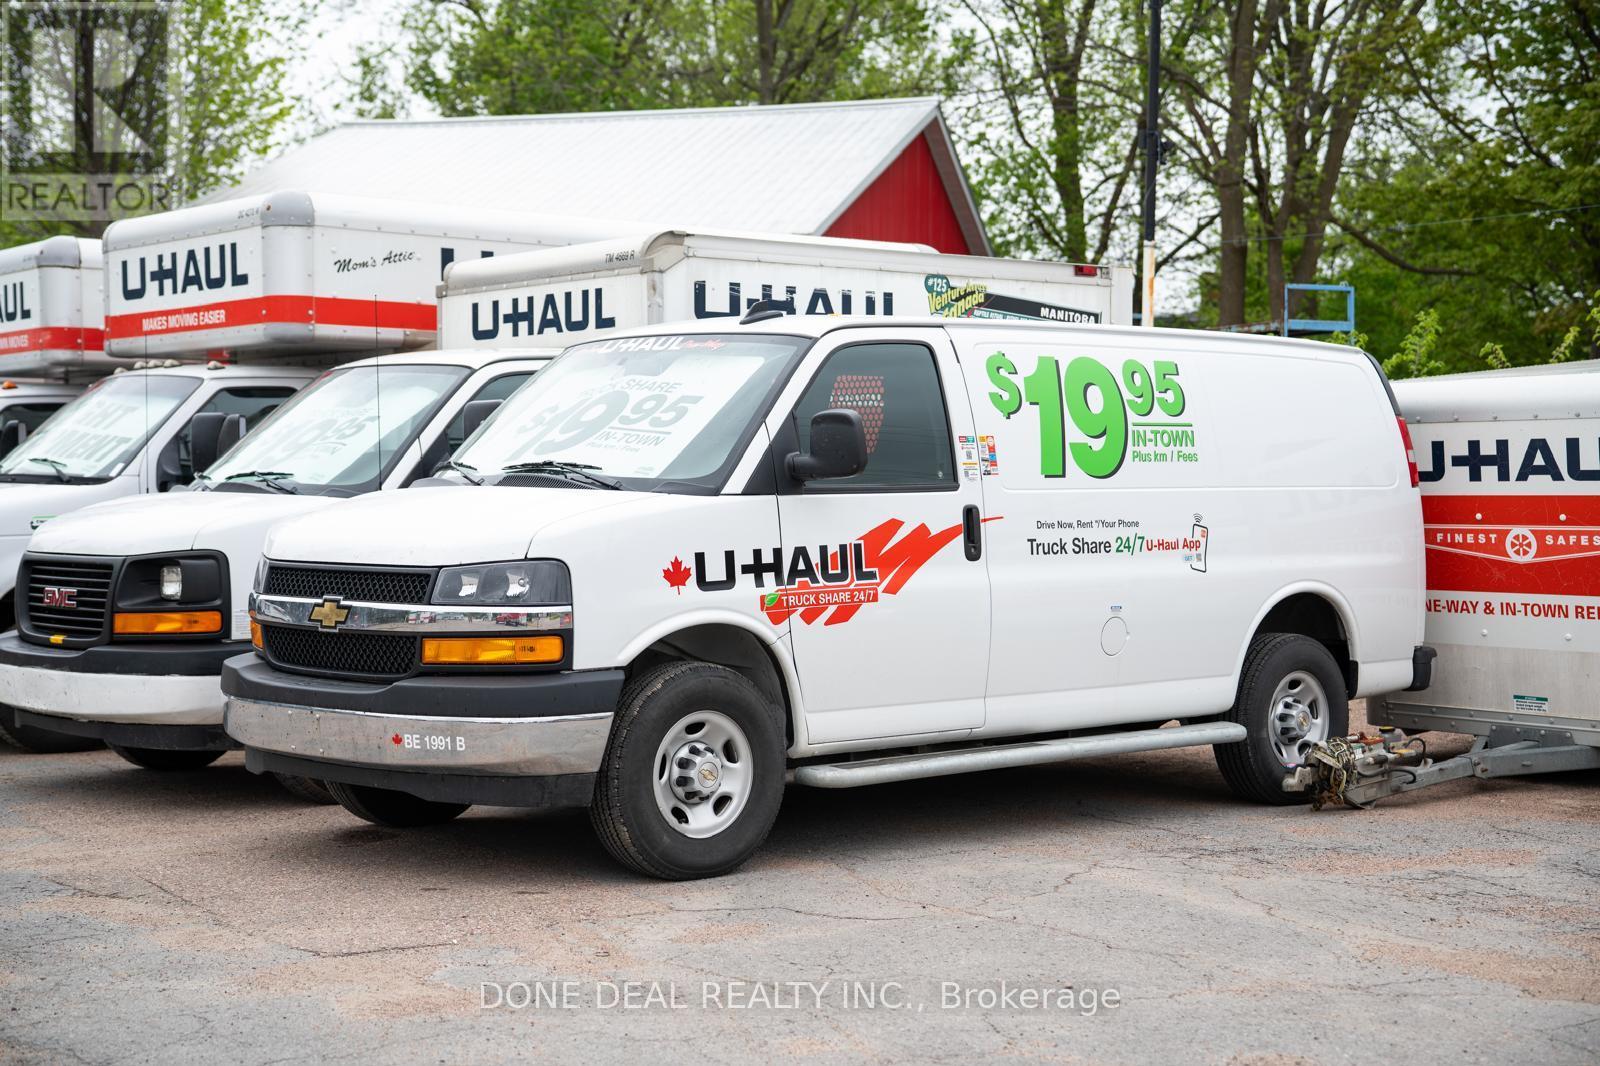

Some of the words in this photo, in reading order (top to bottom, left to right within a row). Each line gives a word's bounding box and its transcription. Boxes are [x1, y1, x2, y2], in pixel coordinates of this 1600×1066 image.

[333, 258, 377, 273] Mom's
[381, 250, 415, 266] Attic
[121, 242, 248, 301] U-HAUL
[927, 277, 947, 293] #125
[142, 316, 167, 332] MAKES
[168, 313, 198, 329] MOVING
[199, 309, 226, 327] EASIER
[472, 287, 616, 341] U-HAUL
[598, 337, 685, 353] U-HAUL
[622, 378, 682, 394] SHARE
[1132, 429, 1195, 448] IN-TOWN
[1132, 450, 1152, 463] Plus
[1153, 450, 1168, 463] km
[1177, 450, 1198, 463] Fees
[1036, 520, 1055, 529] Drive
[1057, 520, 1075, 530] Now,
[1077, 520, 1093, 529] Rent
[1118, 519, 1139, 528] Phone
[1027, 538, 1068, 555] Truck
[1072, 537, 1112, 554] Share
[1115, 532, 1145, 556] 24/7
[1146, 538, 1179, 551] U-Haul
[1182, 537, 1201, 551] App
[1437, 533, 1498, 544] FINEST
[695, 541, 878, 592] U-HAUL
[43, 587, 77, 608] GMC
[782, 594, 816, 607] TRUCK
[819, 592, 851, 604] SHARE
[853, 589, 875, 602] 24/7
[1483, 601, 1495, 615] &
[1501, 602, 1569, 619] IN-TOWN
[404, 734, 421, 749] BE
[424, 735, 451, 751] 1991
[456, 736, 466, 751] B
